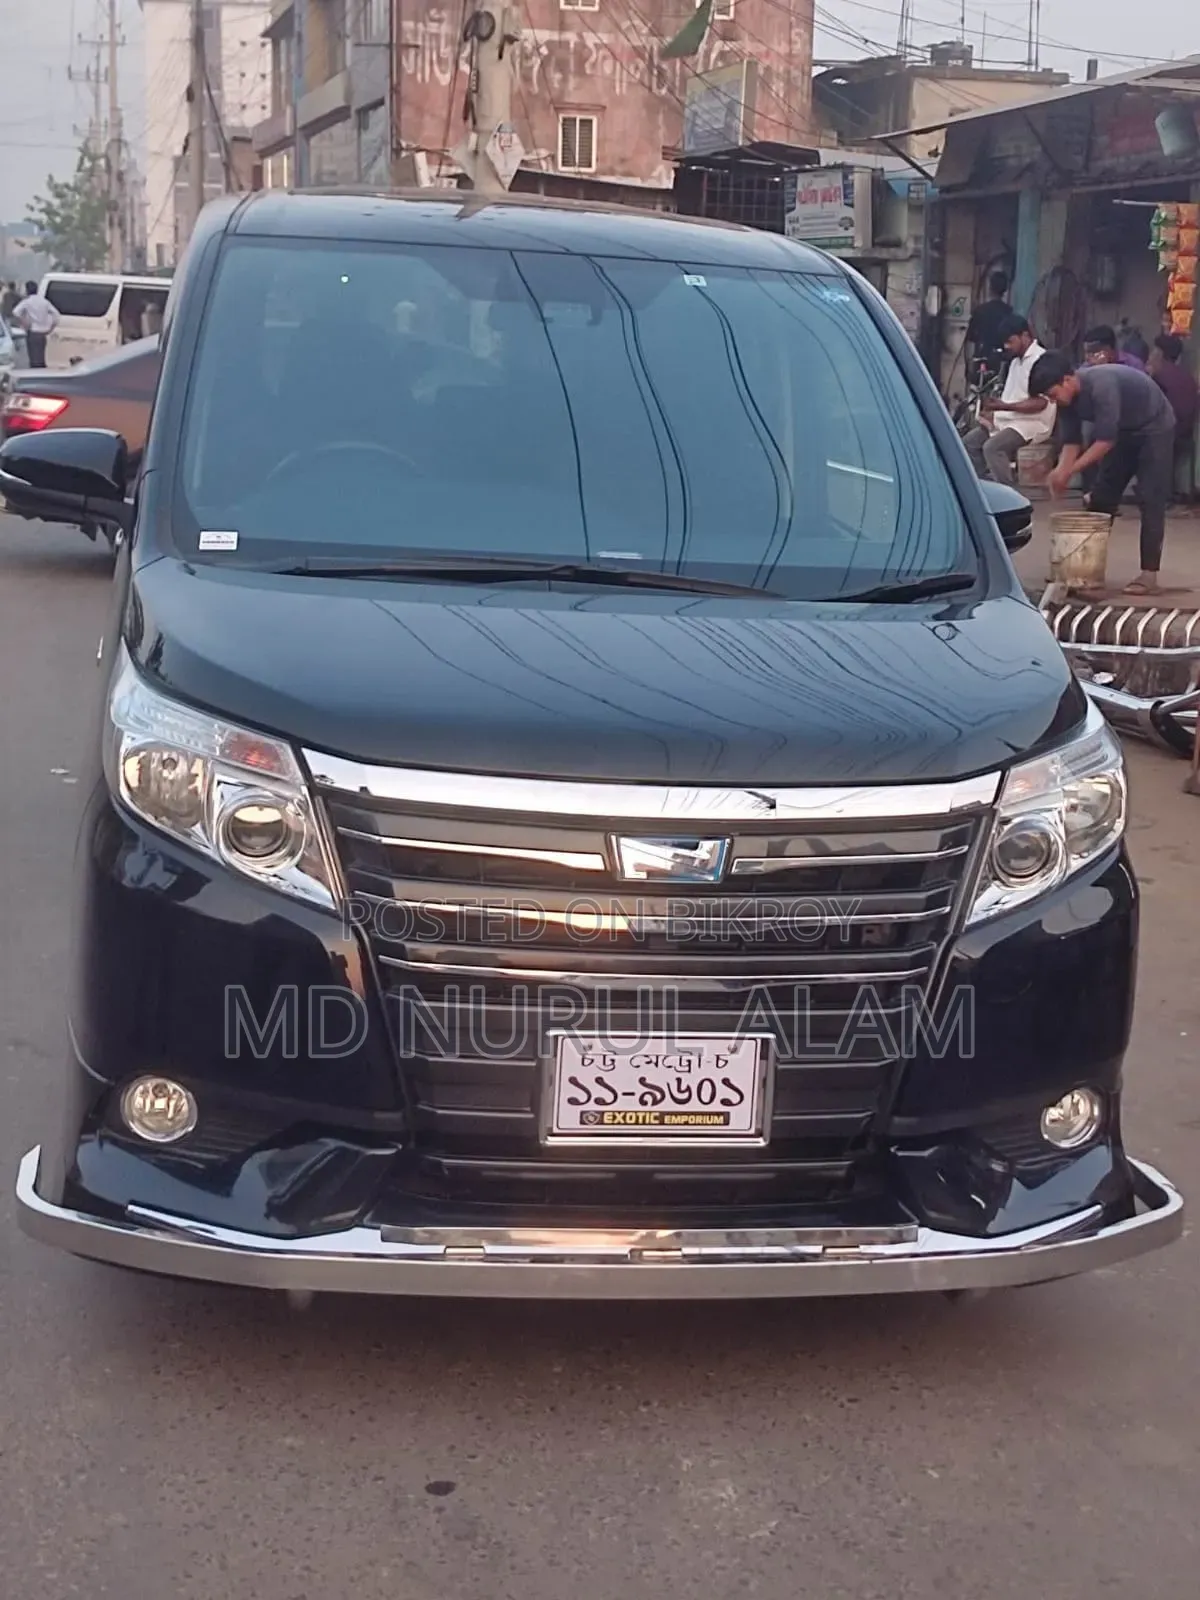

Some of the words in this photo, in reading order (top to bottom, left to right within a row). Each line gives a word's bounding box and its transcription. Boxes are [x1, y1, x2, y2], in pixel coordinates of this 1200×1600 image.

[567, 1076, 745, 1107] ১১-৯৬০১
[603, 1111, 660, 1125] EXOTIC
[664, 1114, 724, 1125] EMPORIUM
